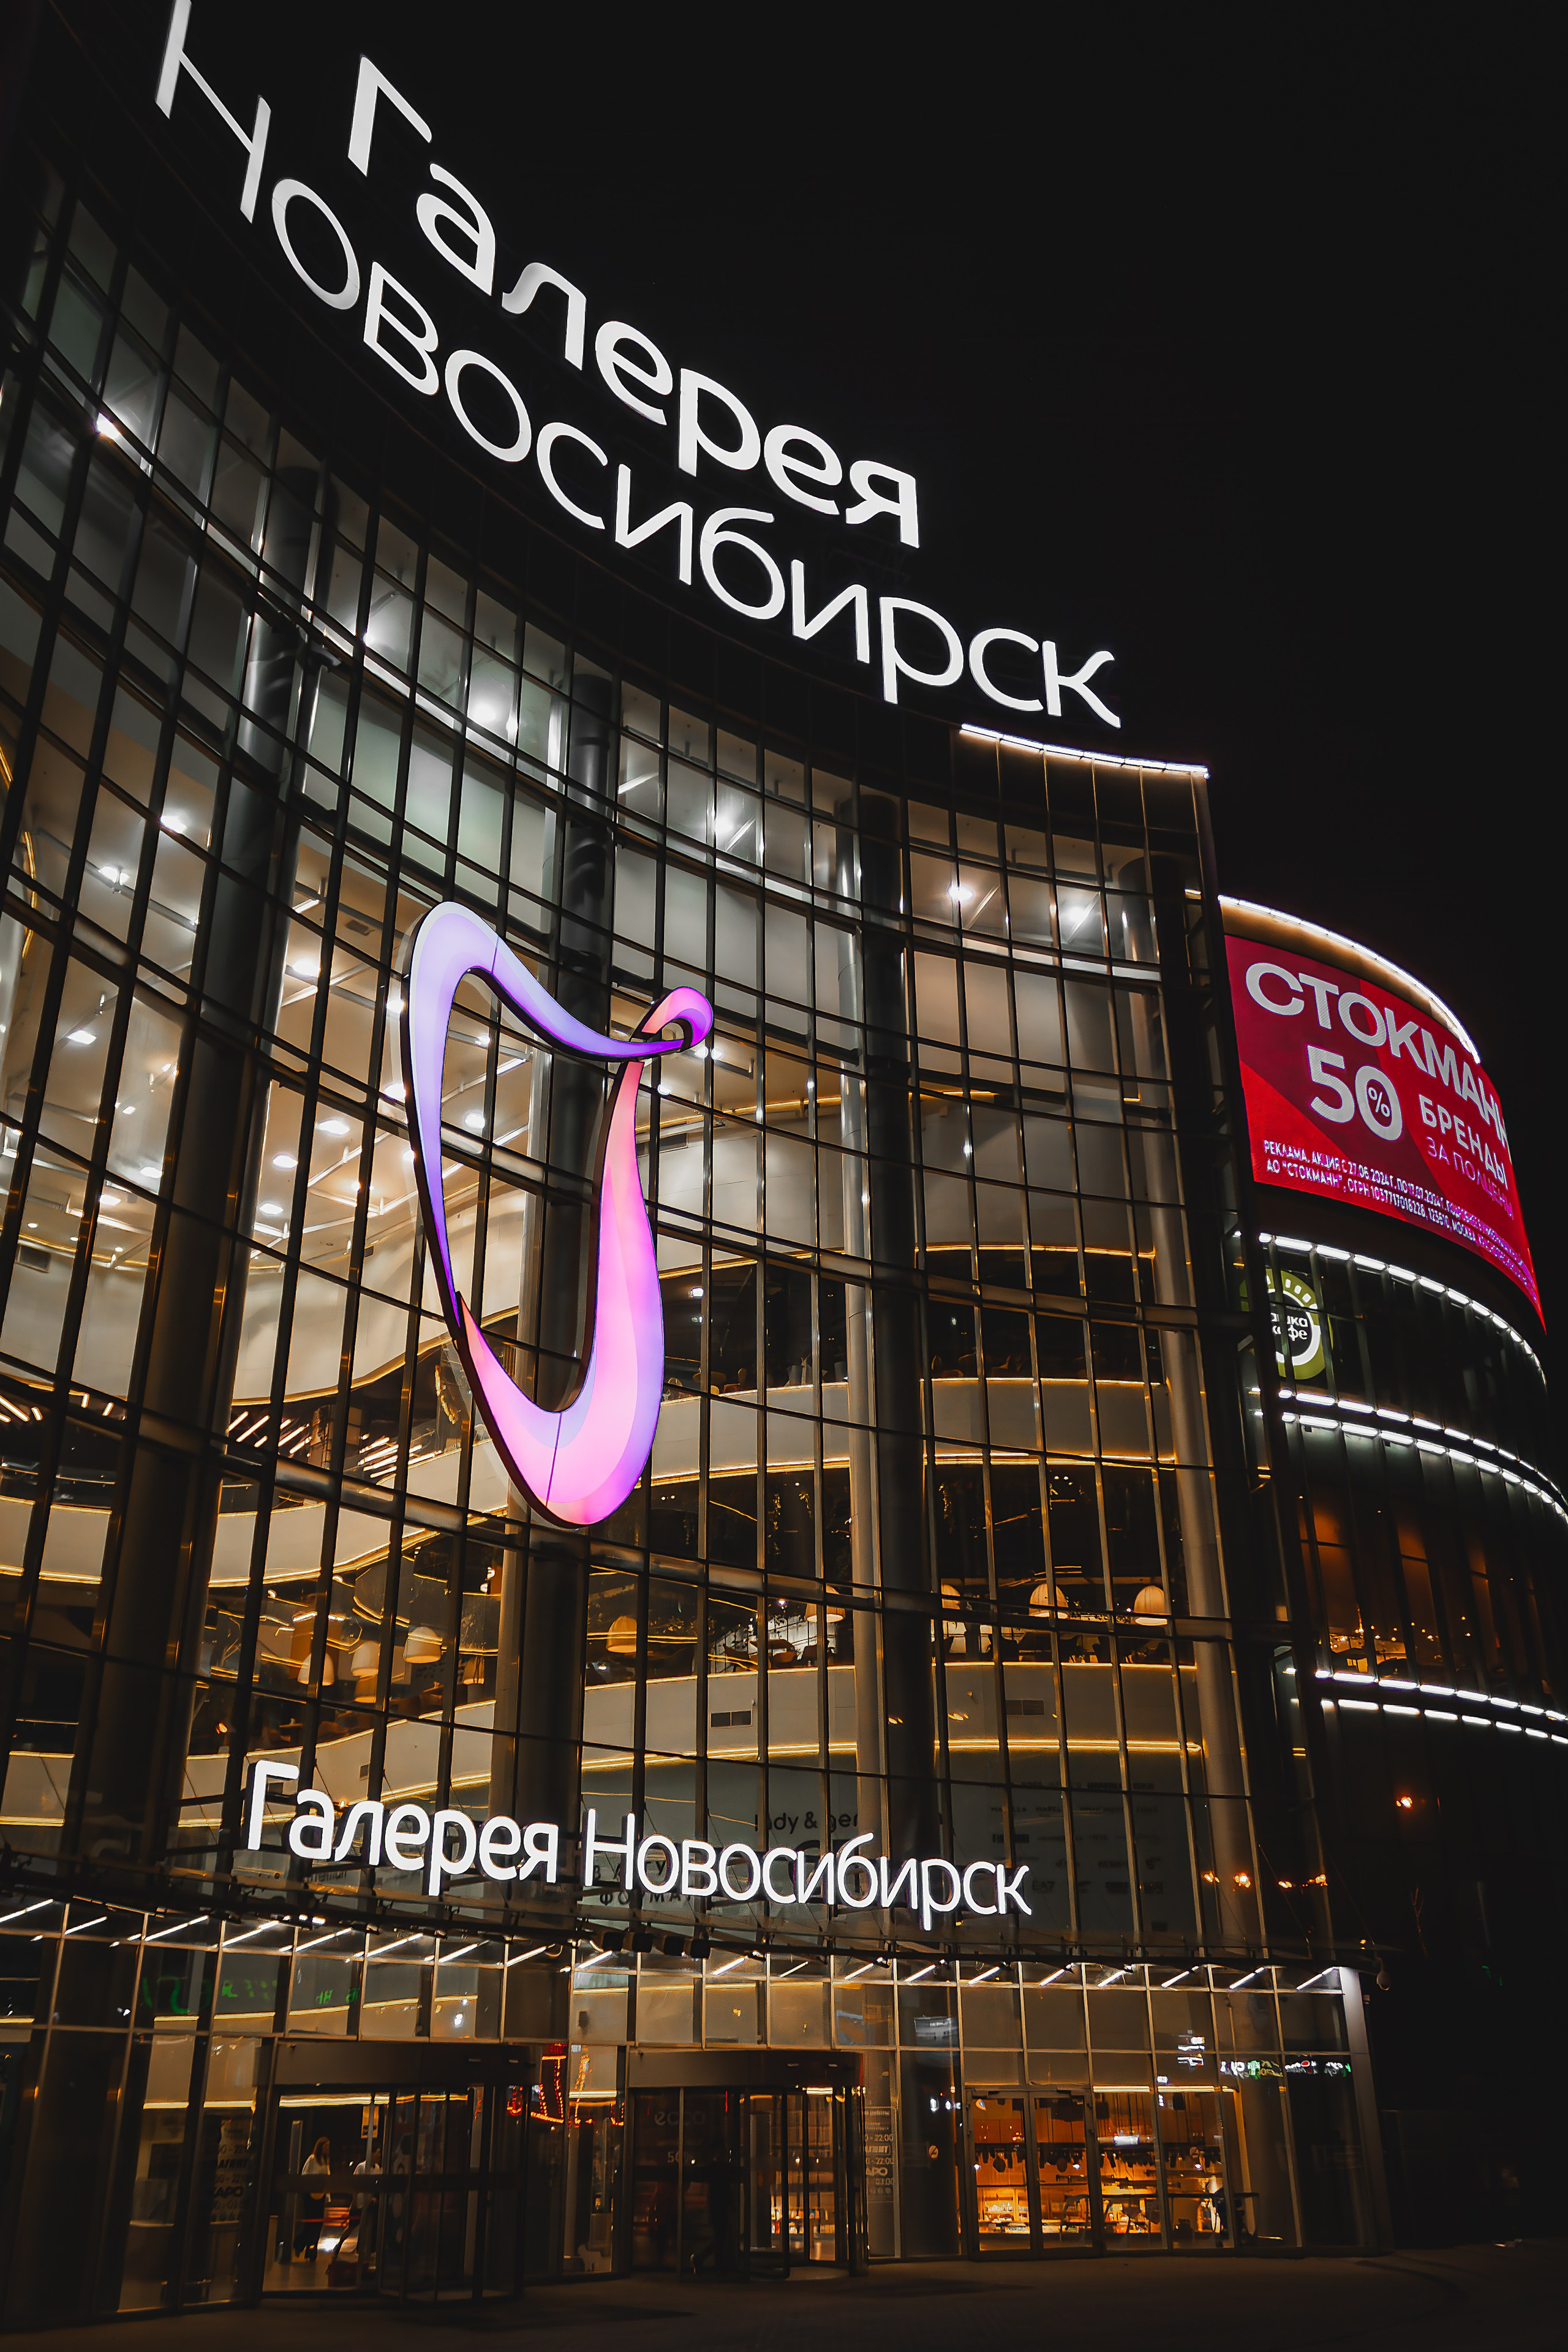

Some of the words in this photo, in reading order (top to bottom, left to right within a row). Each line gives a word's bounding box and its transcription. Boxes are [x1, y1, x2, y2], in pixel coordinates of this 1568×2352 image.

[156, 0, 1120, 728] Новосибирск
[348, 57, 919, 548] Галерея
[1419, 1094, 1508, 1191] БРЕНДЫ
[1426, 1136, 1450, 1165] ЗА
[248, 1760, 558, 1896] Галерея
[586, 1809, 1031, 1931] Новосибирск
